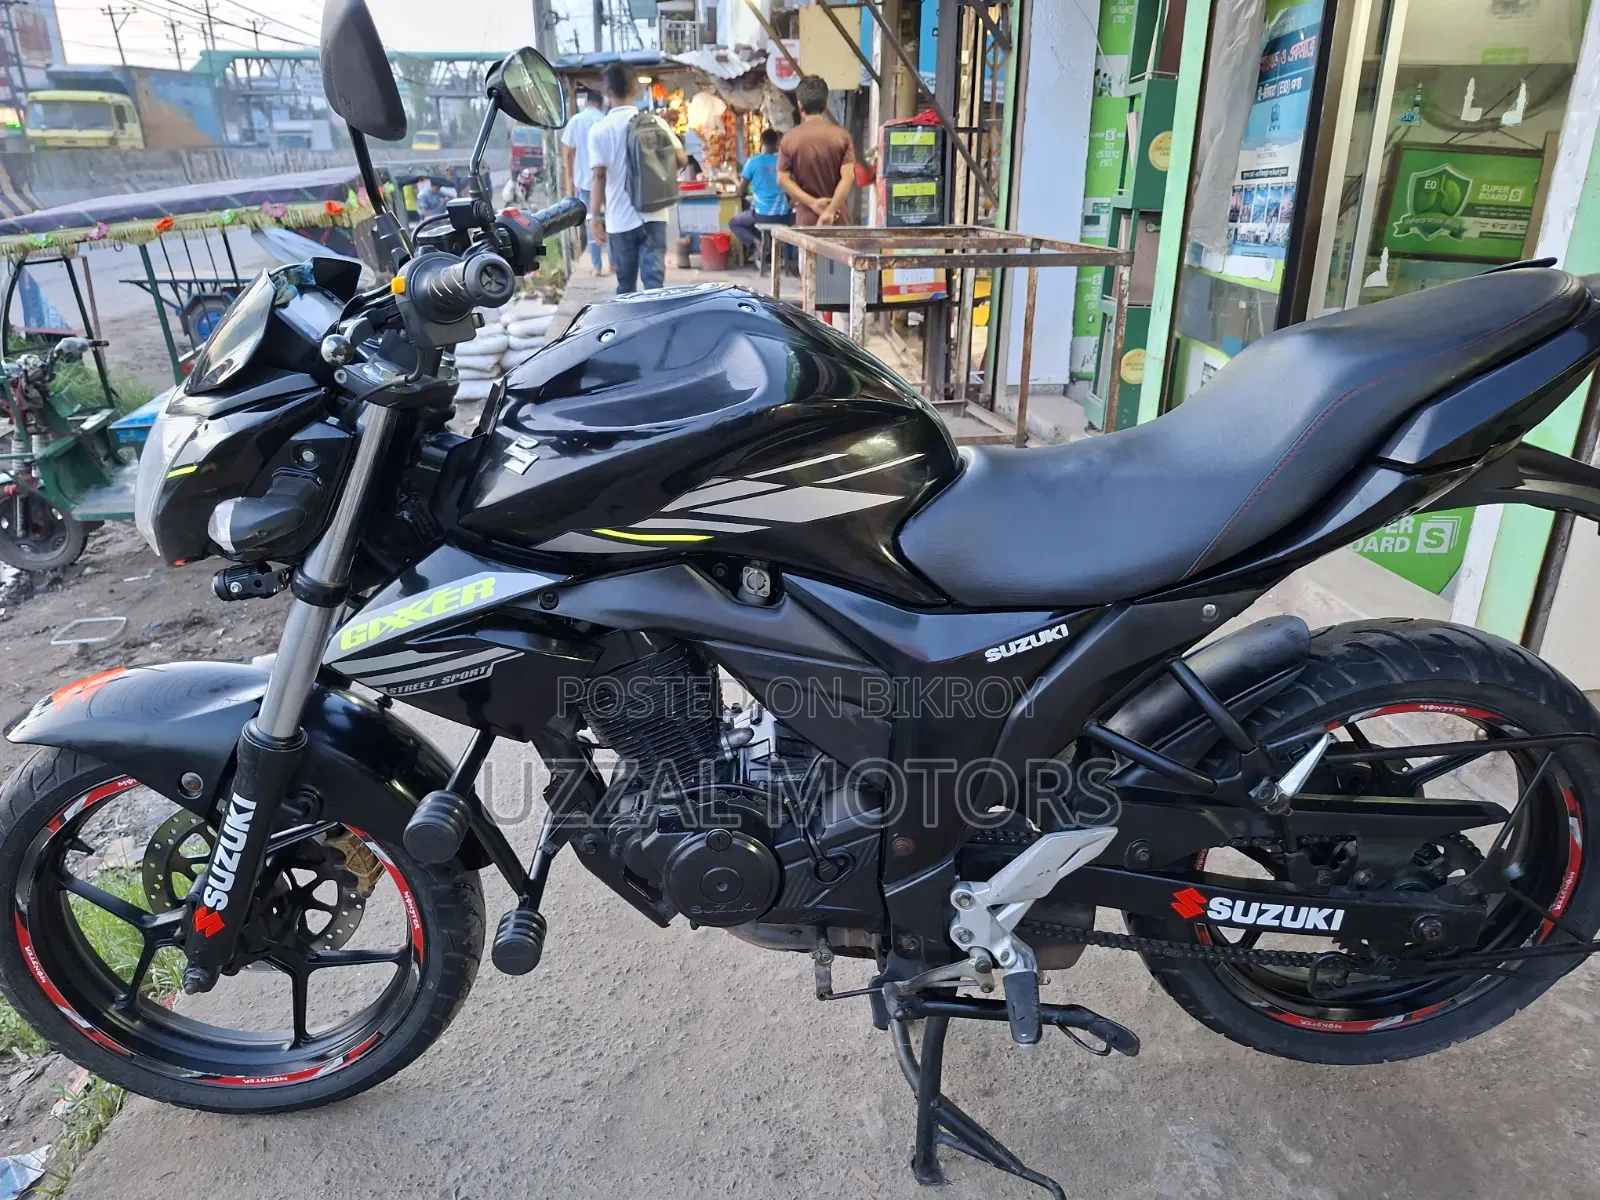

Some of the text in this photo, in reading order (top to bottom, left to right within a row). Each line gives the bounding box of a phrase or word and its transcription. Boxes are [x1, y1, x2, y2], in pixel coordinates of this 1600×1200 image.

[1478, 192, 1508, 201] BOARD
[1481, 183, 1510, 194] SUPER
[1350, 537, 1411, 553] OARD
[1422, 526, 1447, 550] S
[340, 576, 496, 650] GIXXER
[984, 623, 1069, 663] SUZUKI
[388, 665, 489, 694] STREET SPORT
[1418, 704, 1468, 714] MONSTER
[203, 791, 258, 911] SUZUKI
[403, 891, 420, 930] MONSTER
[1206, 897, 1346, 931] SUZUKI
[24, 945, 47, 984] MONSTER
[242, 1076, 288, 1084] MONSTER
